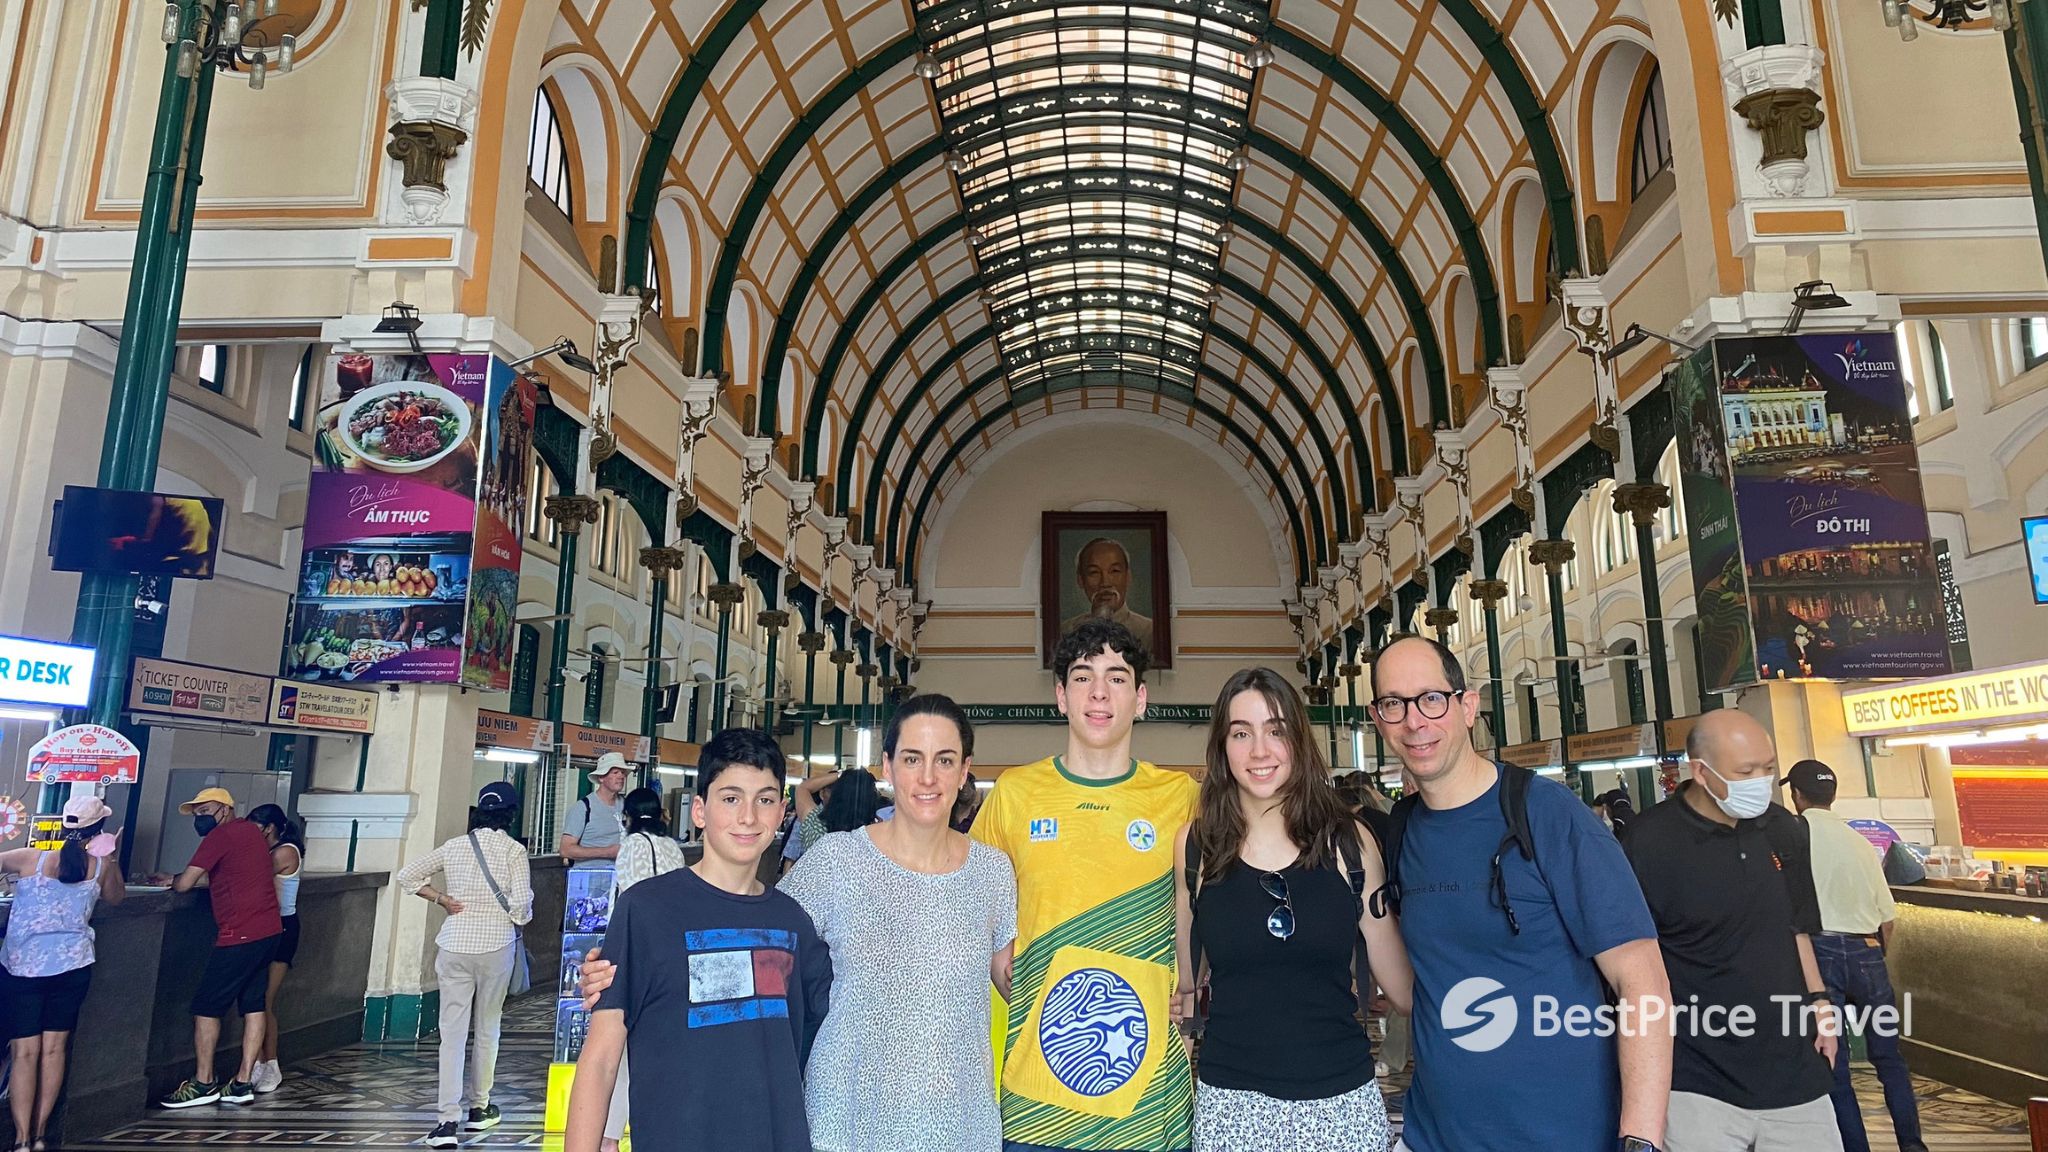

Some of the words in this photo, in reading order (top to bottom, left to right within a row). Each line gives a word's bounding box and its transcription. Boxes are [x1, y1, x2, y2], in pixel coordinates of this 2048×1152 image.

[449, 367, 485, 386] Vietnam
[1833, 352, 1896, 381] Vietnam
[348, 485, 375, 507] Du
[377, 480, 400, 500] lịch
[1786, 495, 1812, 518] Du
[1817, 489, 1838, 510] lịch
[364, 505, 389, 523] ẨM
[391, 509, 431, 526] THỰC
[1701, 522, 1715, 540] SINH
[1714, 514, 1729, 534] THÁI
[1816, 516, 1841, 533] ĐÔ
[1843, 518, 1870, 535] THỊ
[1843, 661, 1945, 670] www.vietnamtourism.gov.vn
[1870, 650, 1943, 658] www.vietnam.travel
[16, 659, 73, 686] DESK
[145, 670, 180, 687] TICKET
[183, 676, 229, 694] COUNTER
[1007, 706, 1044, 717] CHÍNH
[1160, 706, 1190, 717] TOÀN
[1853, 698, 1888, 724] BEST
[1890, 688, 1959, 720] COFFEES
[1961, 685, 1980, 712] IN
[1980, 679, 2019, 709] THE
[43, 732, 67, 748] Hop
[93, 727, 115, 739] Hop
[116, 738, 131, 751] off
[1429, 884, 1437, 892] &
[1440, 881, 1460, 892] Fitch
